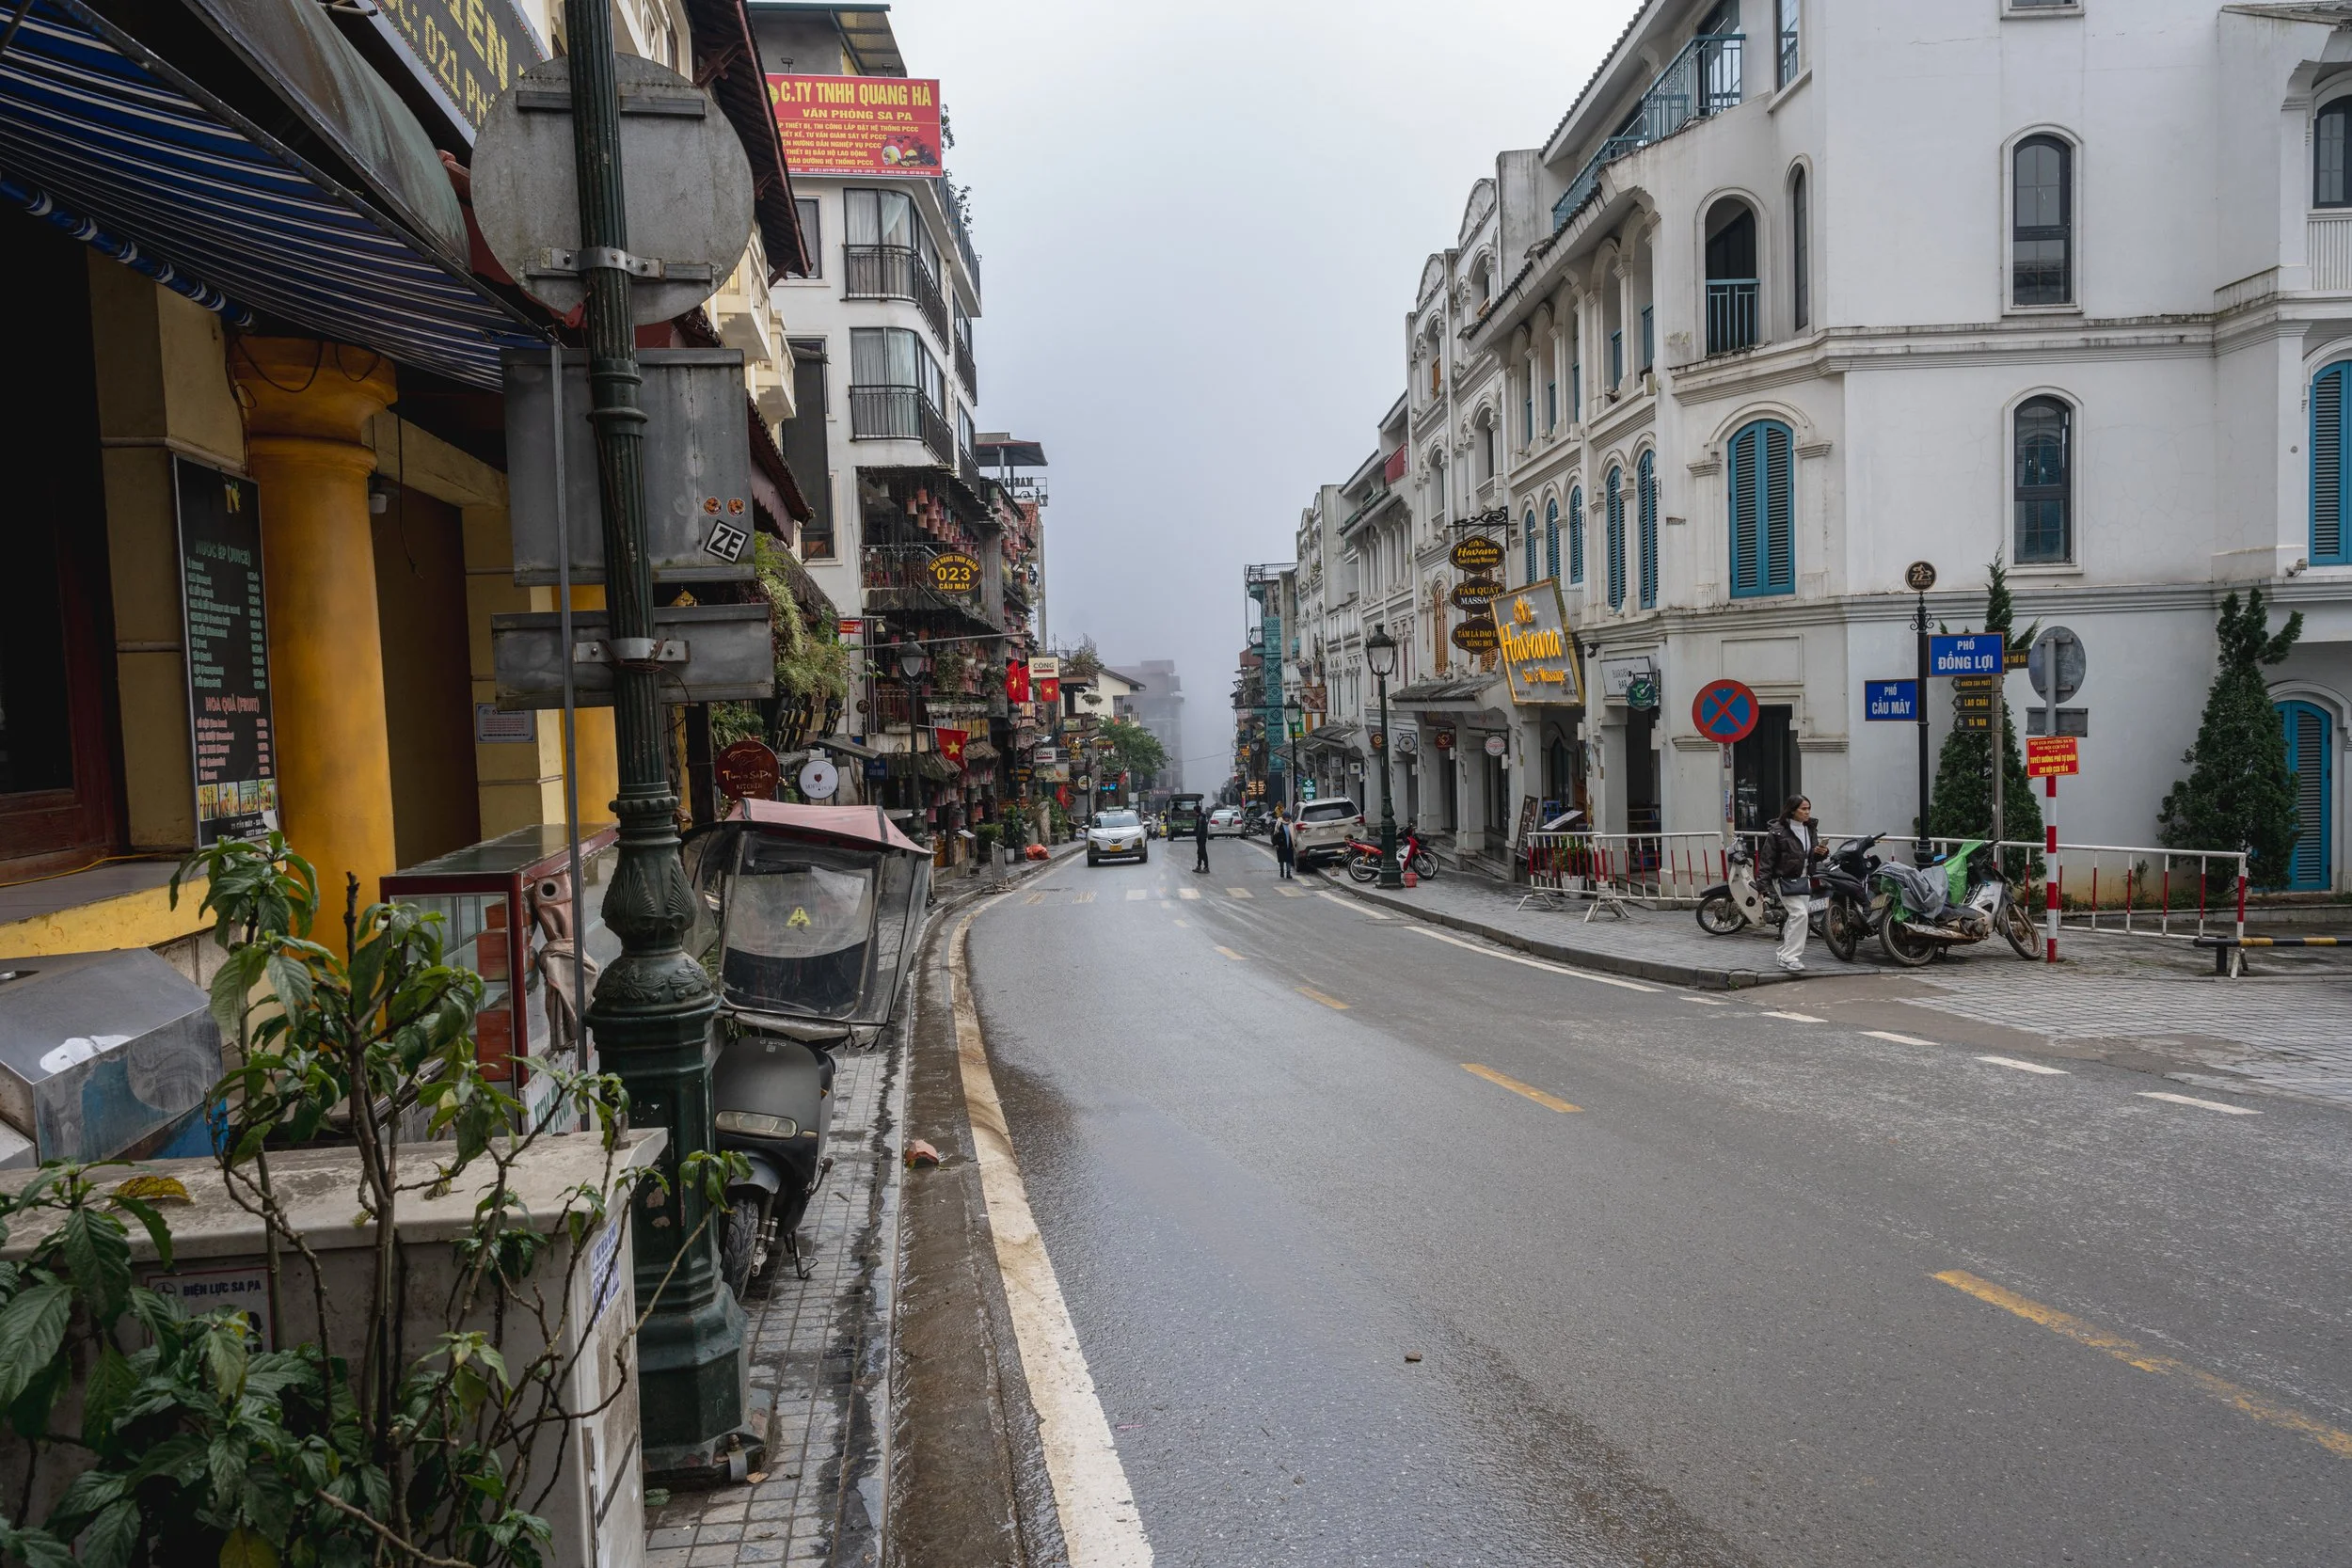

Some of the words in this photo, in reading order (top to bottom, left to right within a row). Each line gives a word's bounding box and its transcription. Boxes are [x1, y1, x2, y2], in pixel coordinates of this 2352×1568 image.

[425, 15, 461, 99] 021
[781, 81, 812, 103] C.TY
[816, 82, 855, 103] TNHH
[859, 84, 908, 106] QUANG
[912, 82, 932, 106] HÀ
[803, 107, 828, 118] VĂN
[831, 108, 874, 119] PHÒNG
[877, 111, 894, 120] SA
[897, 112, 913, 120] PA
[709, 525, 744, 559] ZE
[1457, 547, 1498, 558] Havana
[937, 567, 971, 581] 023
[1460, 597, 1490, 606] MASSA
[1500, 622, 1563, 667] Havana
[1957, 637, 1975, 650] PHỐ
[1975, 655, 1994, 672] LỢI
[1538, 666, 1565, 686] Massage
[1883, 682, 1898, 696] PHỐ
[205, 696, 221, 712] HOA
[1871, 696, 1889, 715] CẦU
[1891, 699, 1911, 715] MÂY
[1964, 698, 1974, 706] LAO
[183, 1282, 207, 1297] ĐIỆN
[210, 1281, 229, 1295] LỰC
[231, 1280, 245, 1291] SA
[247, 1279, 262, 1292] PA
